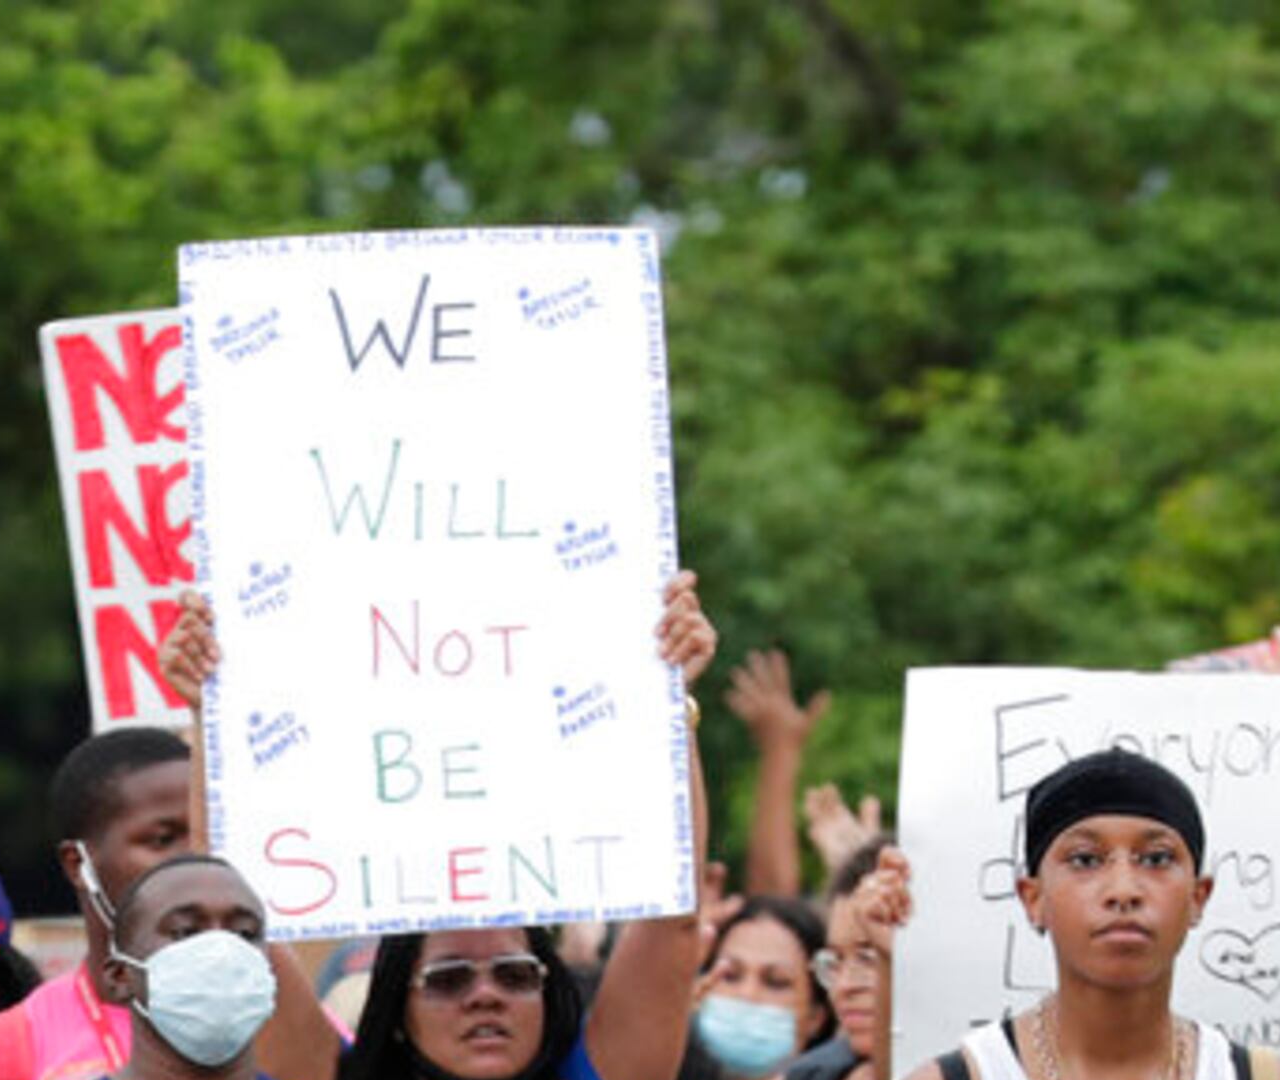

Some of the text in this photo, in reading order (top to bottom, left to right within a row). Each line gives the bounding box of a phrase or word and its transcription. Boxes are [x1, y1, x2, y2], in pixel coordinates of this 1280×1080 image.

[327, 273, 477, 373] WE
[308, 437, 542, 542] WILL
[370, 598, 531, 678] NOT
[372, 728, 486, 804] BE
[263, 826, 625, 917] SILENT
